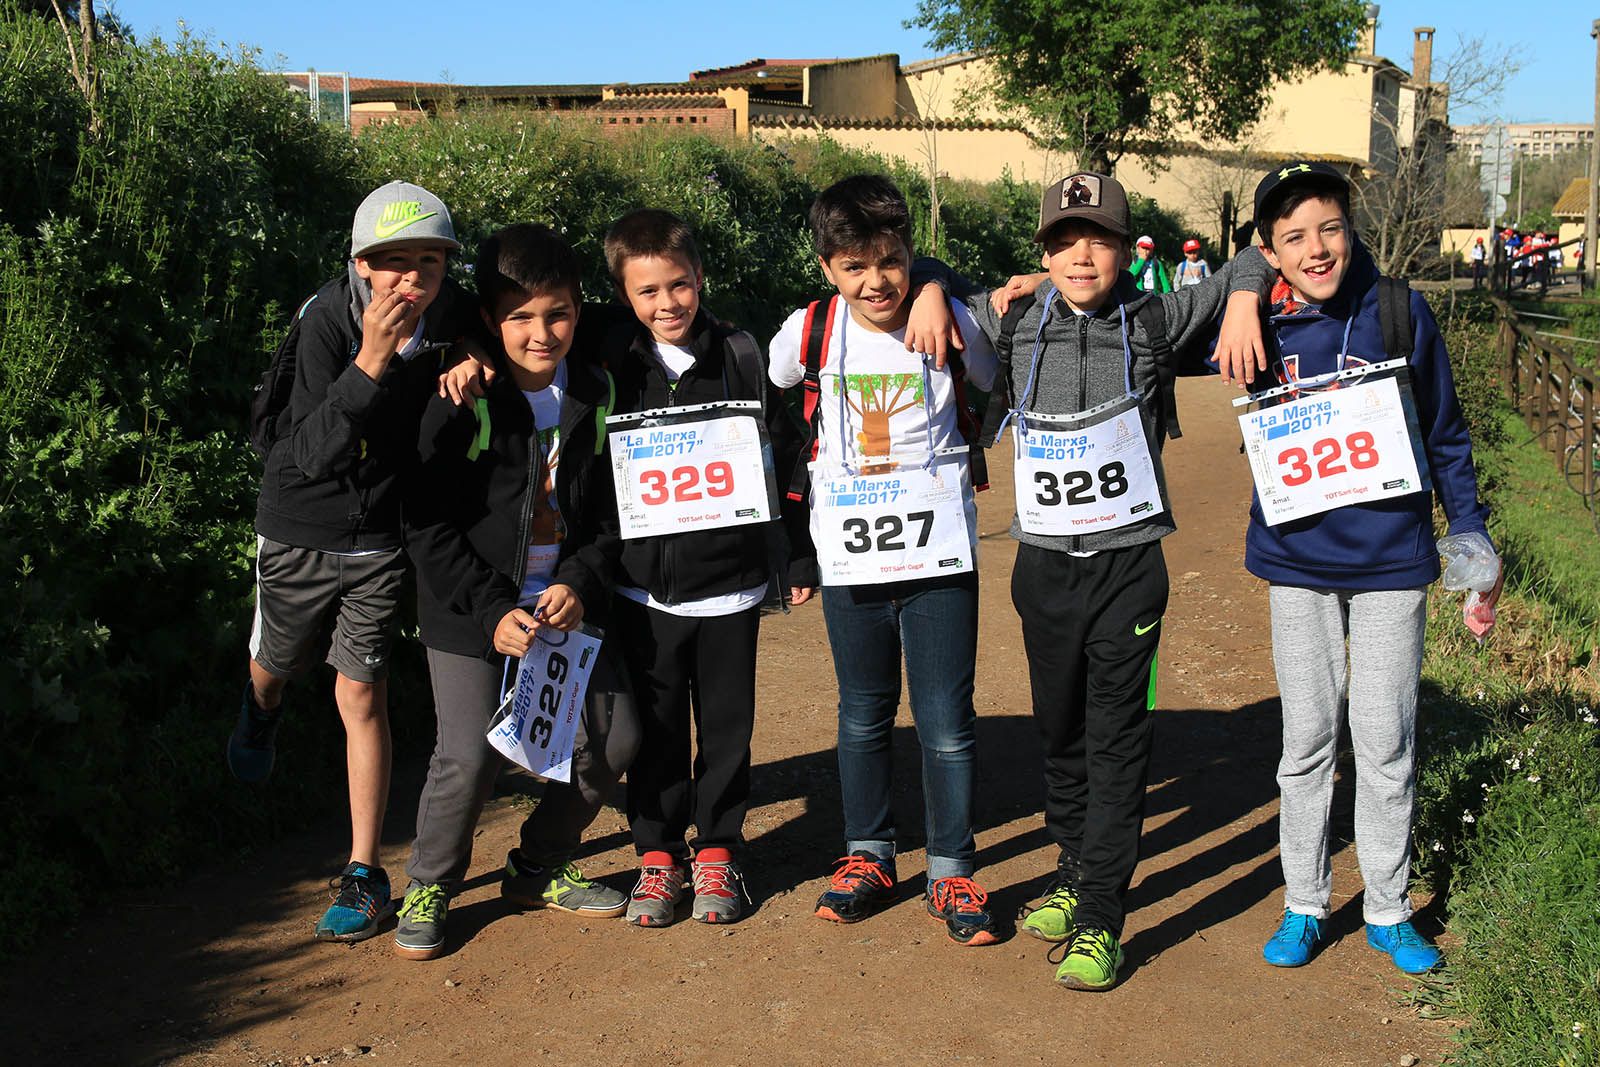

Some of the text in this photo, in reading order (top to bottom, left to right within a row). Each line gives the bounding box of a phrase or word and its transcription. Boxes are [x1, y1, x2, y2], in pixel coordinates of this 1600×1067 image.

[382, 201, 421, 221] NIKE
[1251, 414, 1277, 428] “La
[1283, 400, 1332, 422] Marxa
[1290, 409, 1340, 434] 2017”
[619, 430, 697, 447] “La Marxa
[655, 439, 703, 457] 2017”
[1041, 434, 1088, 447] Marxa
[1046, 443, 1095, 460] 2017”
[1277, 431, 1380, 487] 328
[639, 461, 735, 506] 329
[824, 479, 901, 494] “La Marxa
[1034, 461, 1129, 506] 328
[857, 489, 907, 505] 2017”
[842, 510, 935, 554] 327
[495, 669, 529, 738] “La Marxa
[519, 666, 535, 719] 2017”
[529, 651, 569, 750] 329
